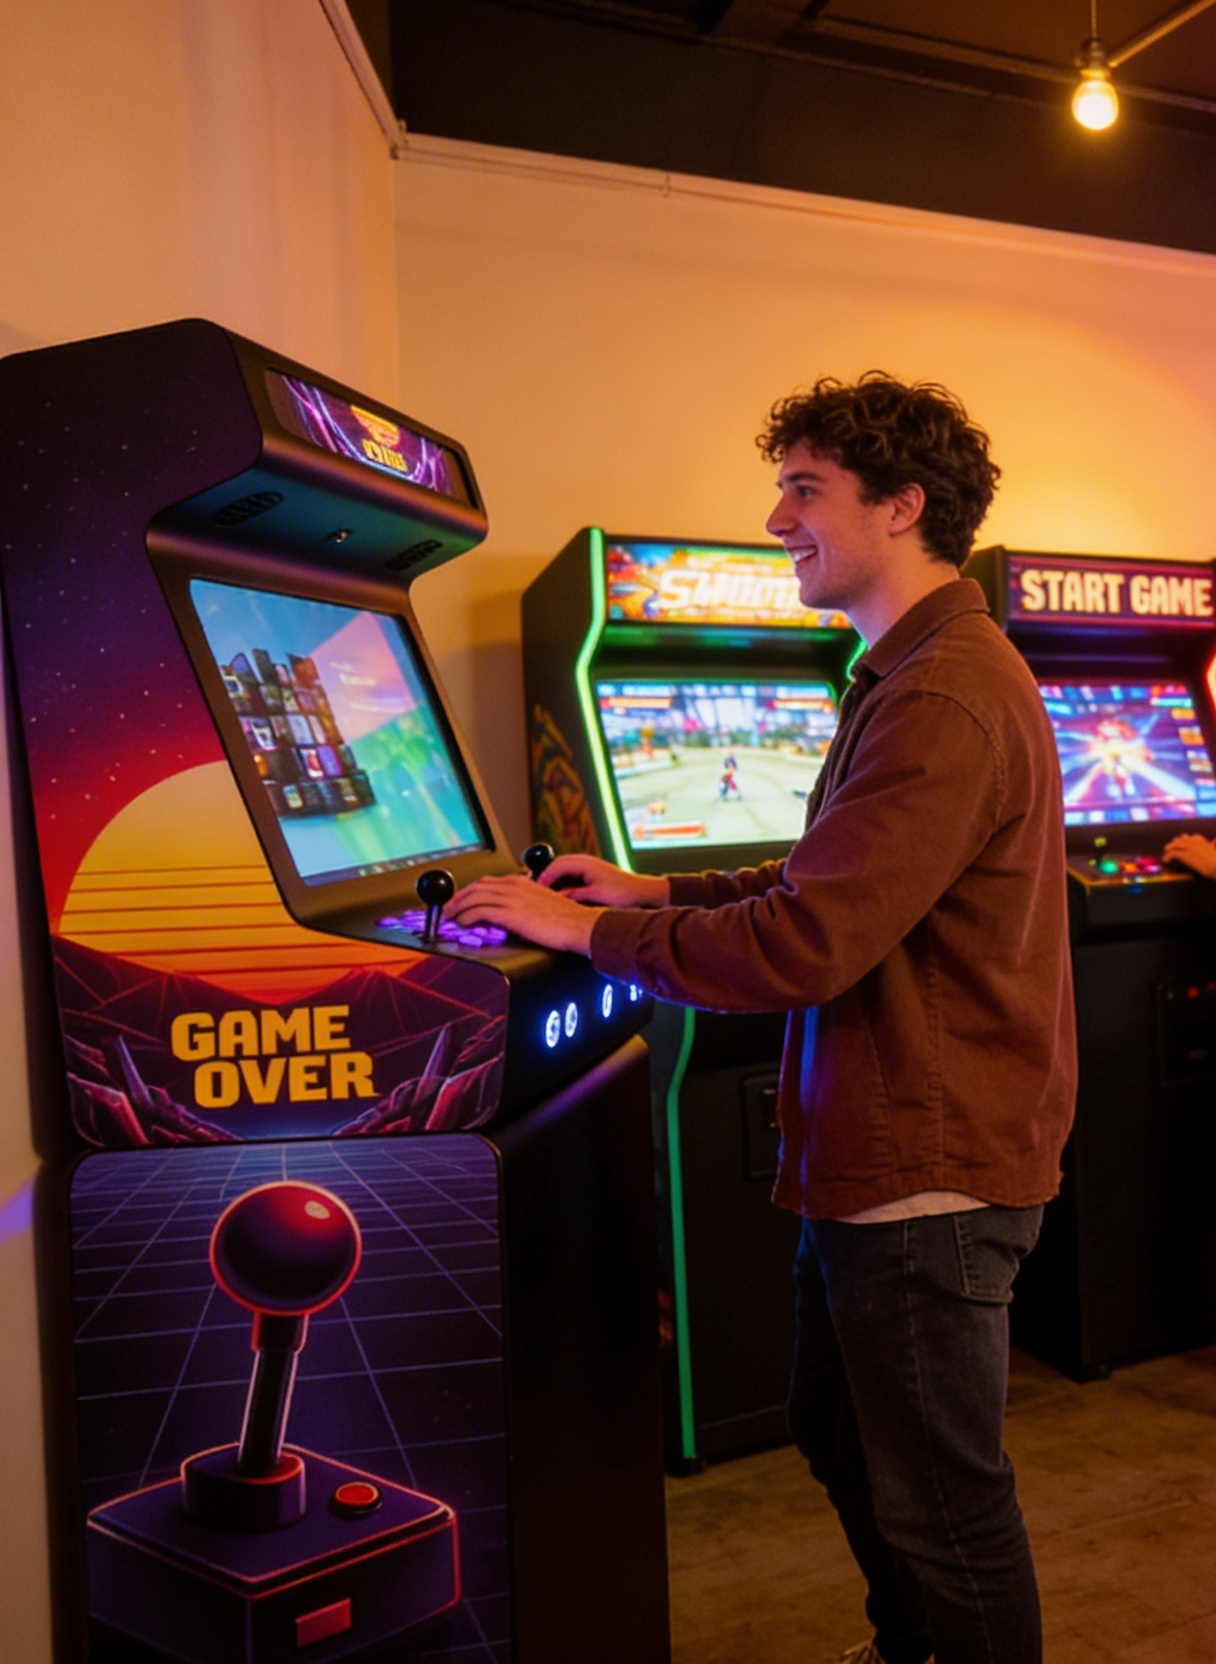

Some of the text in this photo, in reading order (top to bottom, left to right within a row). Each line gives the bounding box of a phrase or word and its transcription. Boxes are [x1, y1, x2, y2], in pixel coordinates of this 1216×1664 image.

[1020, 569, 1214, 616] START GAME
[171, 1005, 351, 1061] GAME
[194, 1051, 381, 1109] OVER
